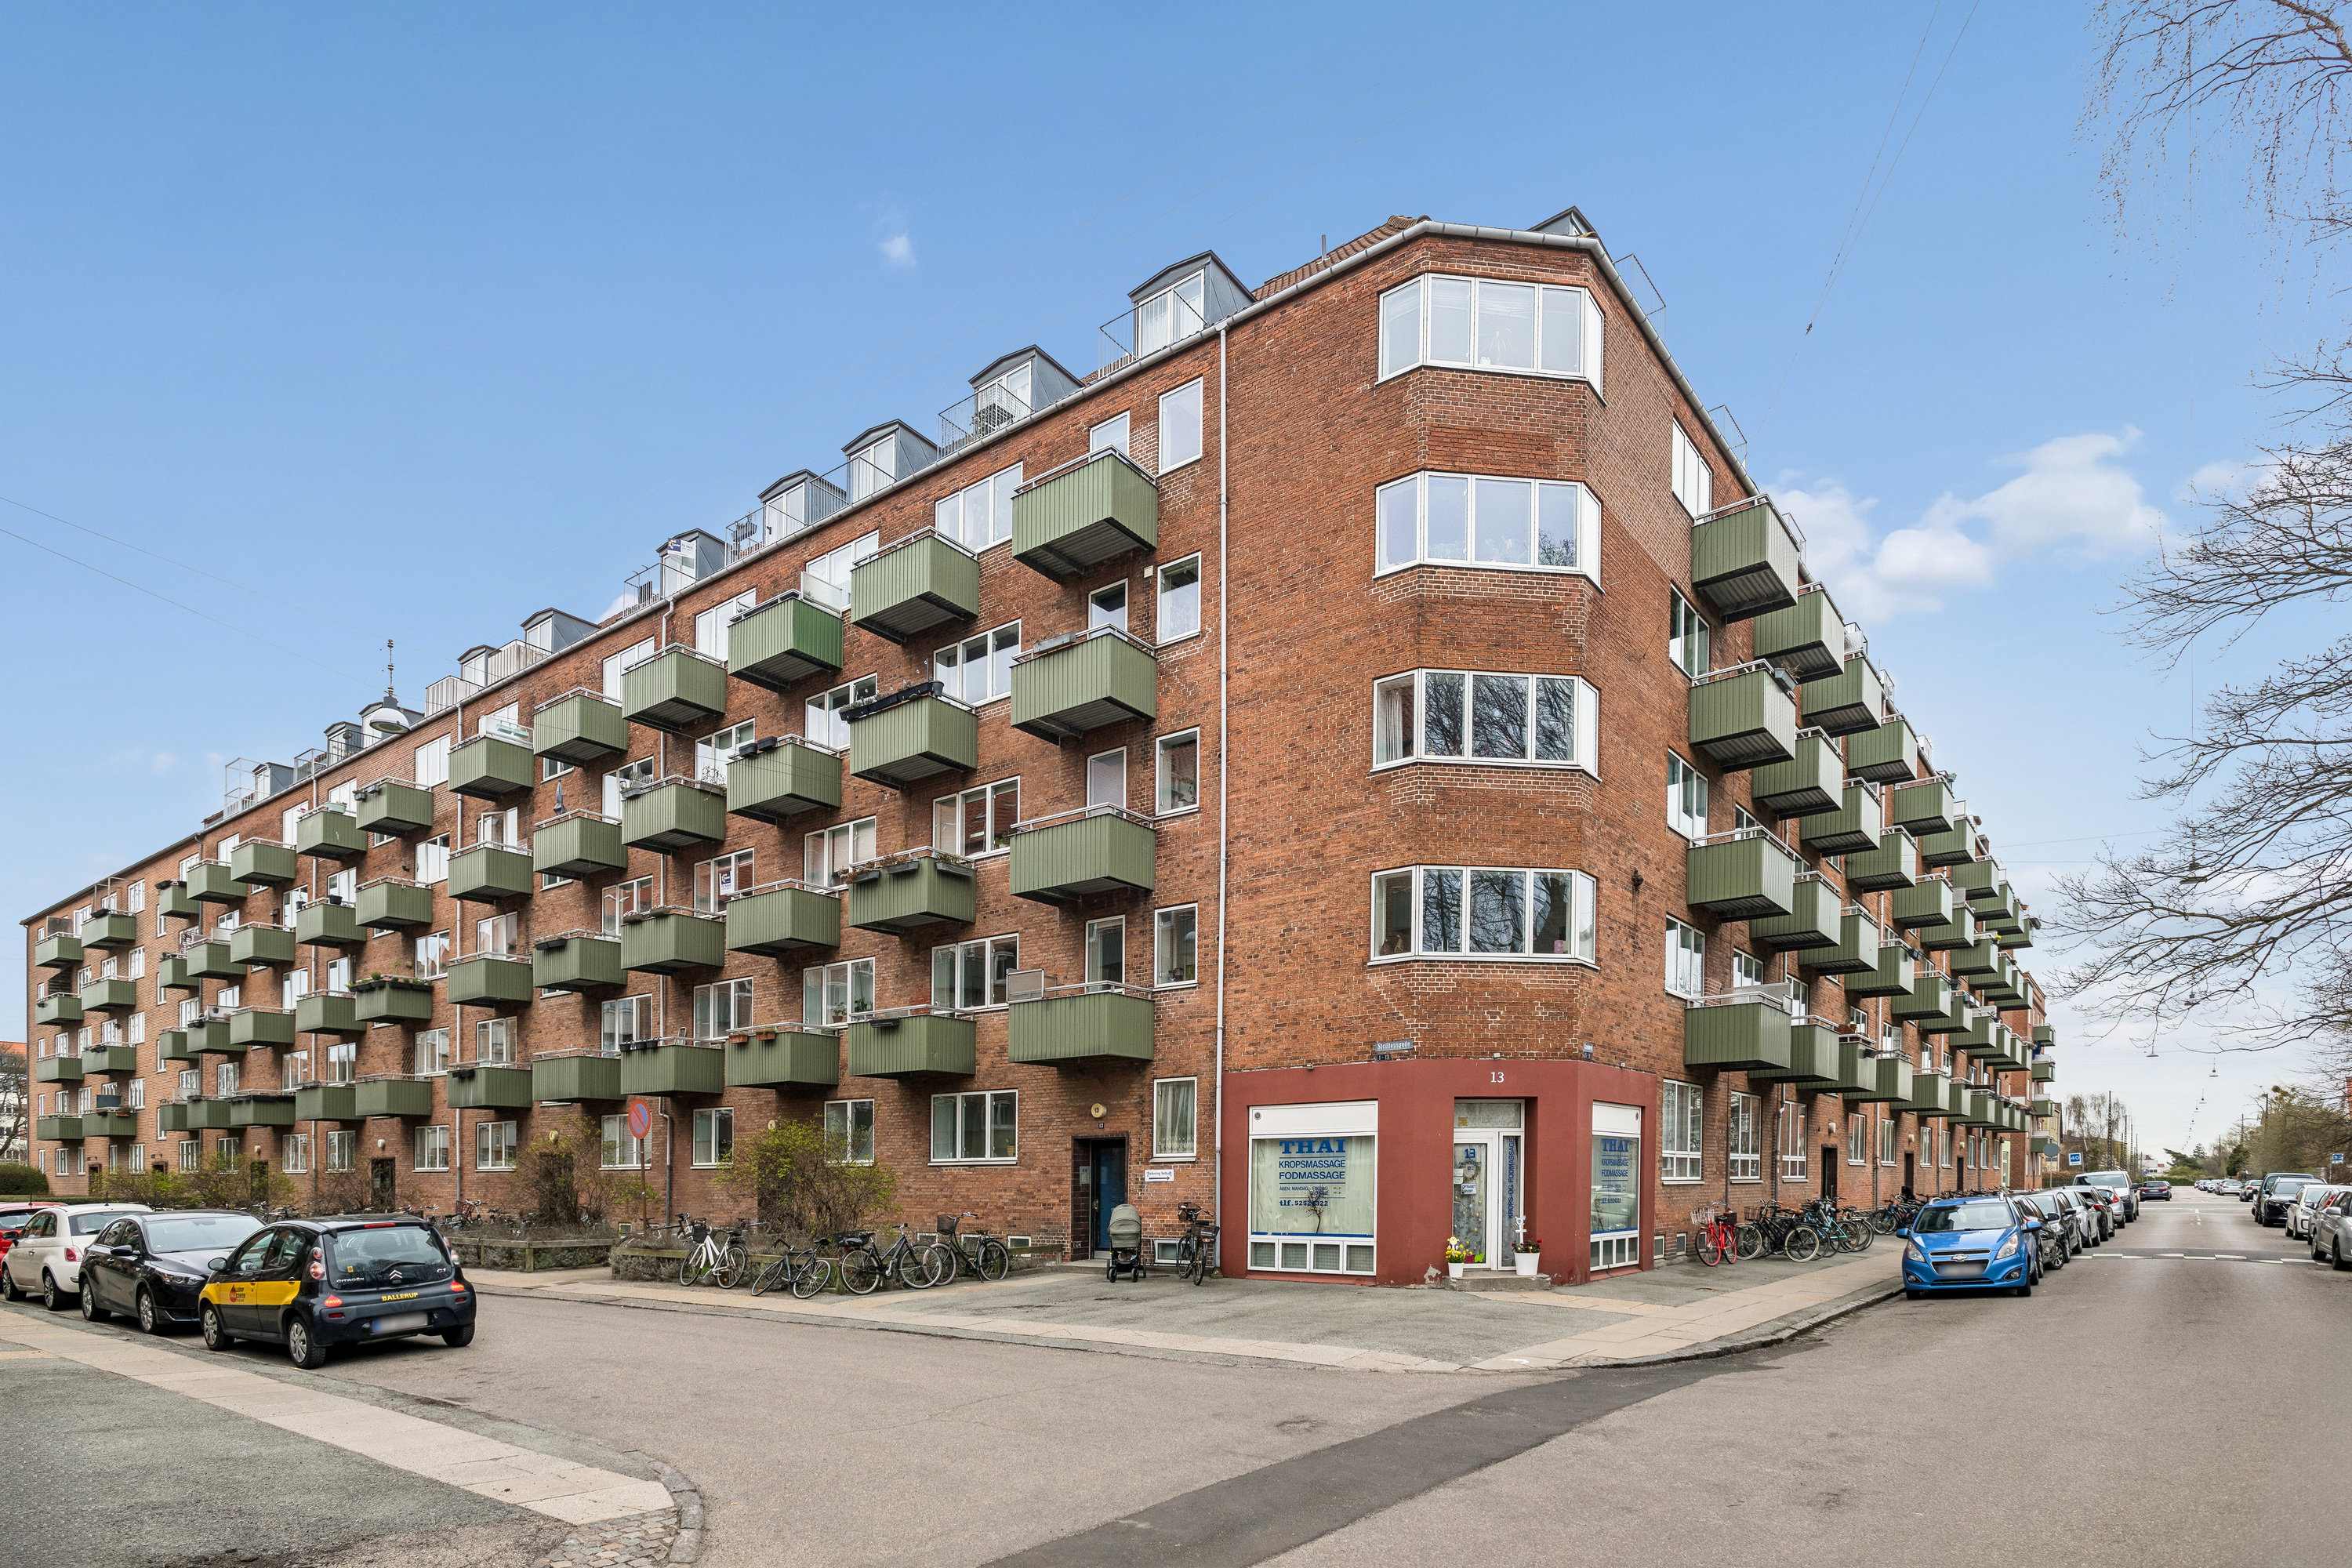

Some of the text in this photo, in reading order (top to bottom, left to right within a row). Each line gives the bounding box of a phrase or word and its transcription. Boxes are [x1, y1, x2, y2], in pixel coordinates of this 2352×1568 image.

[1377, 1040, 1410, 1050] Siciliensgade
[1490, 1071, 1504, 1083] 13
[1279, 1139, 1346, 1154] THAI
[1601, 1138, 1629, 1152] THAI
[1465, 1148, 1476, 1159] 13
[1279, 1160, 1346, 1168] KROPSMASSAGE
[1601, 1158, 1629, 1167] KROPSMASSAGE
[1279, 1171, 1346, 1180] FODMASSAGE
[1601, 1169, 1628, 1178] FODMASSAGE
[381, 1292, 419, 1301] BALLERUP
